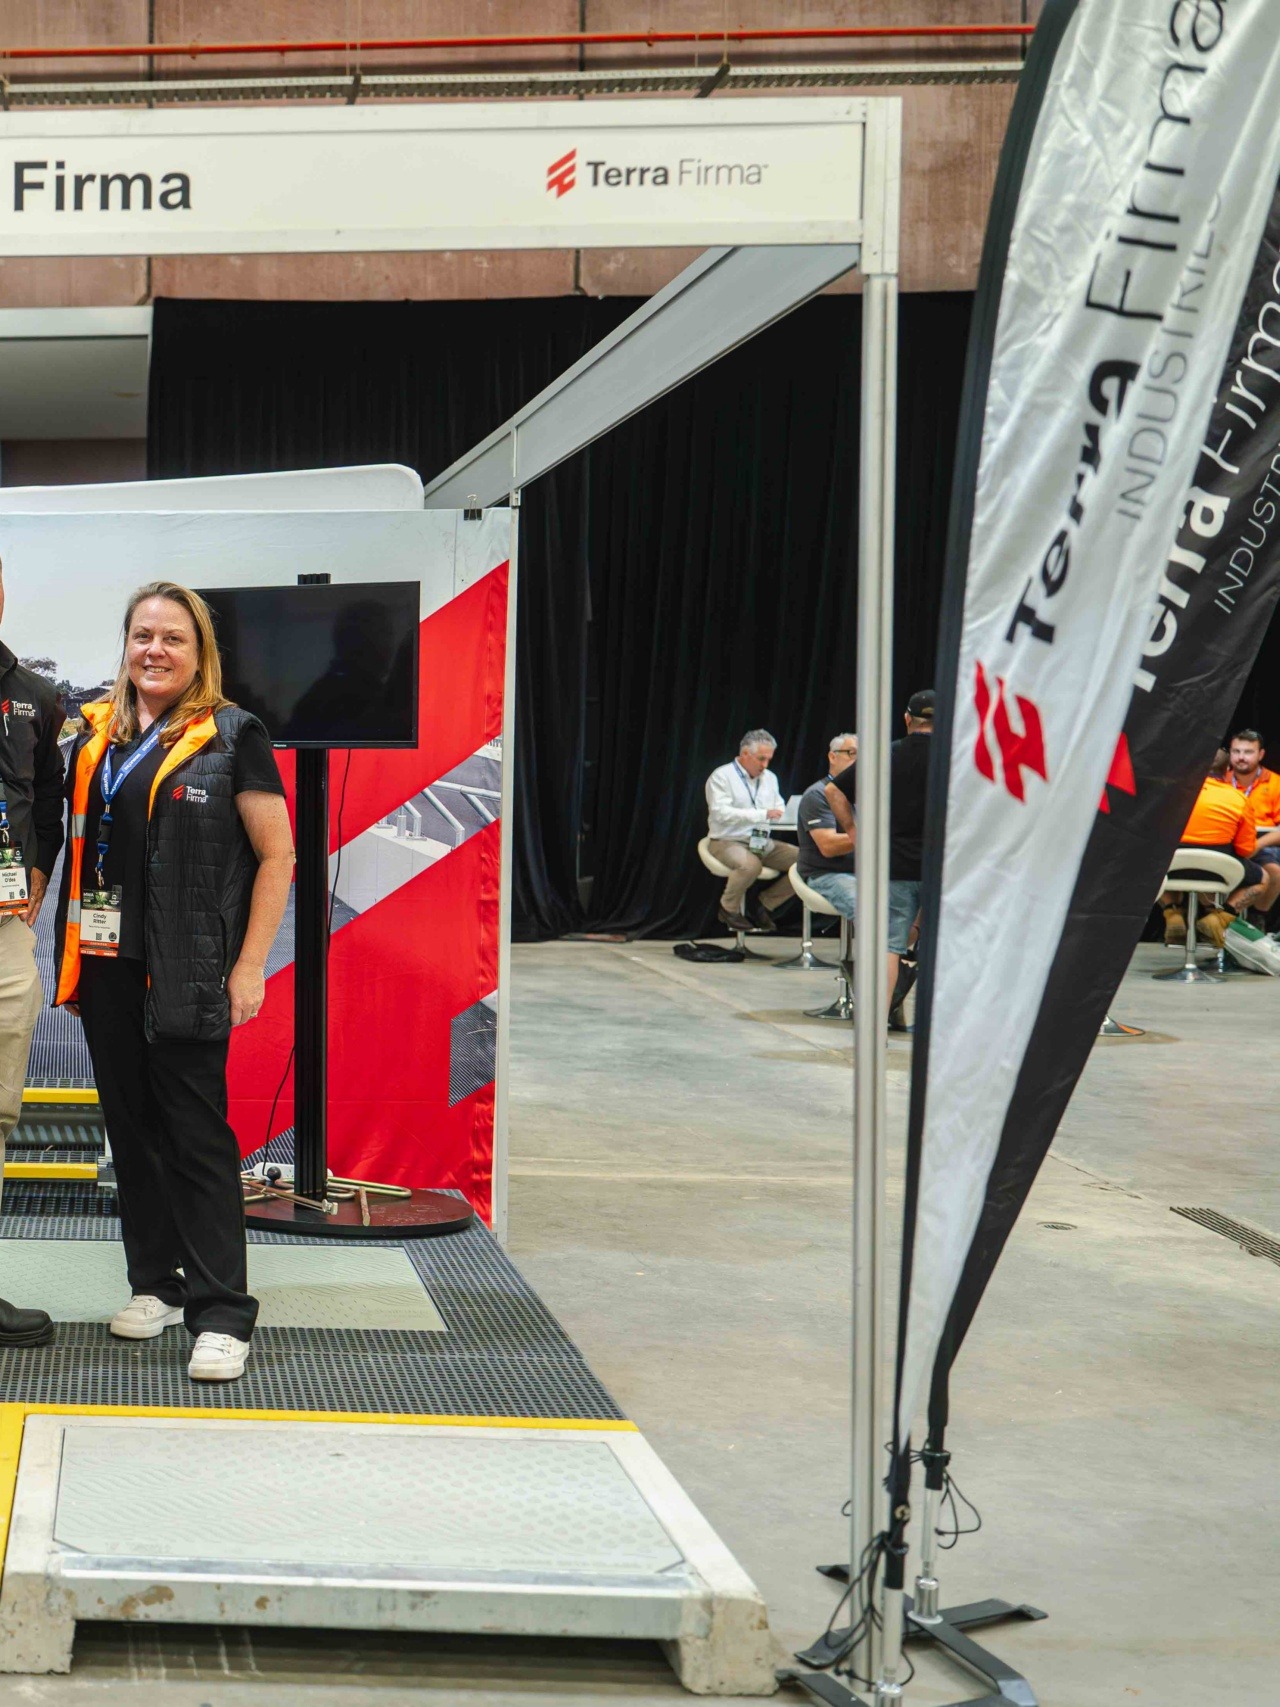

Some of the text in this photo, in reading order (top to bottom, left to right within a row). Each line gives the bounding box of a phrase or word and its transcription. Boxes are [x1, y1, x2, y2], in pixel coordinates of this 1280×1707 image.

[586, 157, 763, 187] Terra Firma
[13, 160, 193, 213] Firma
[1200, 258, 1280, 476] Firm
[11, 700, 33, 710] Terra
[13, 708, 35, 717] Firma
[186, 785, 206, 796] Terra
[185, 793, 208, 803] Firma
